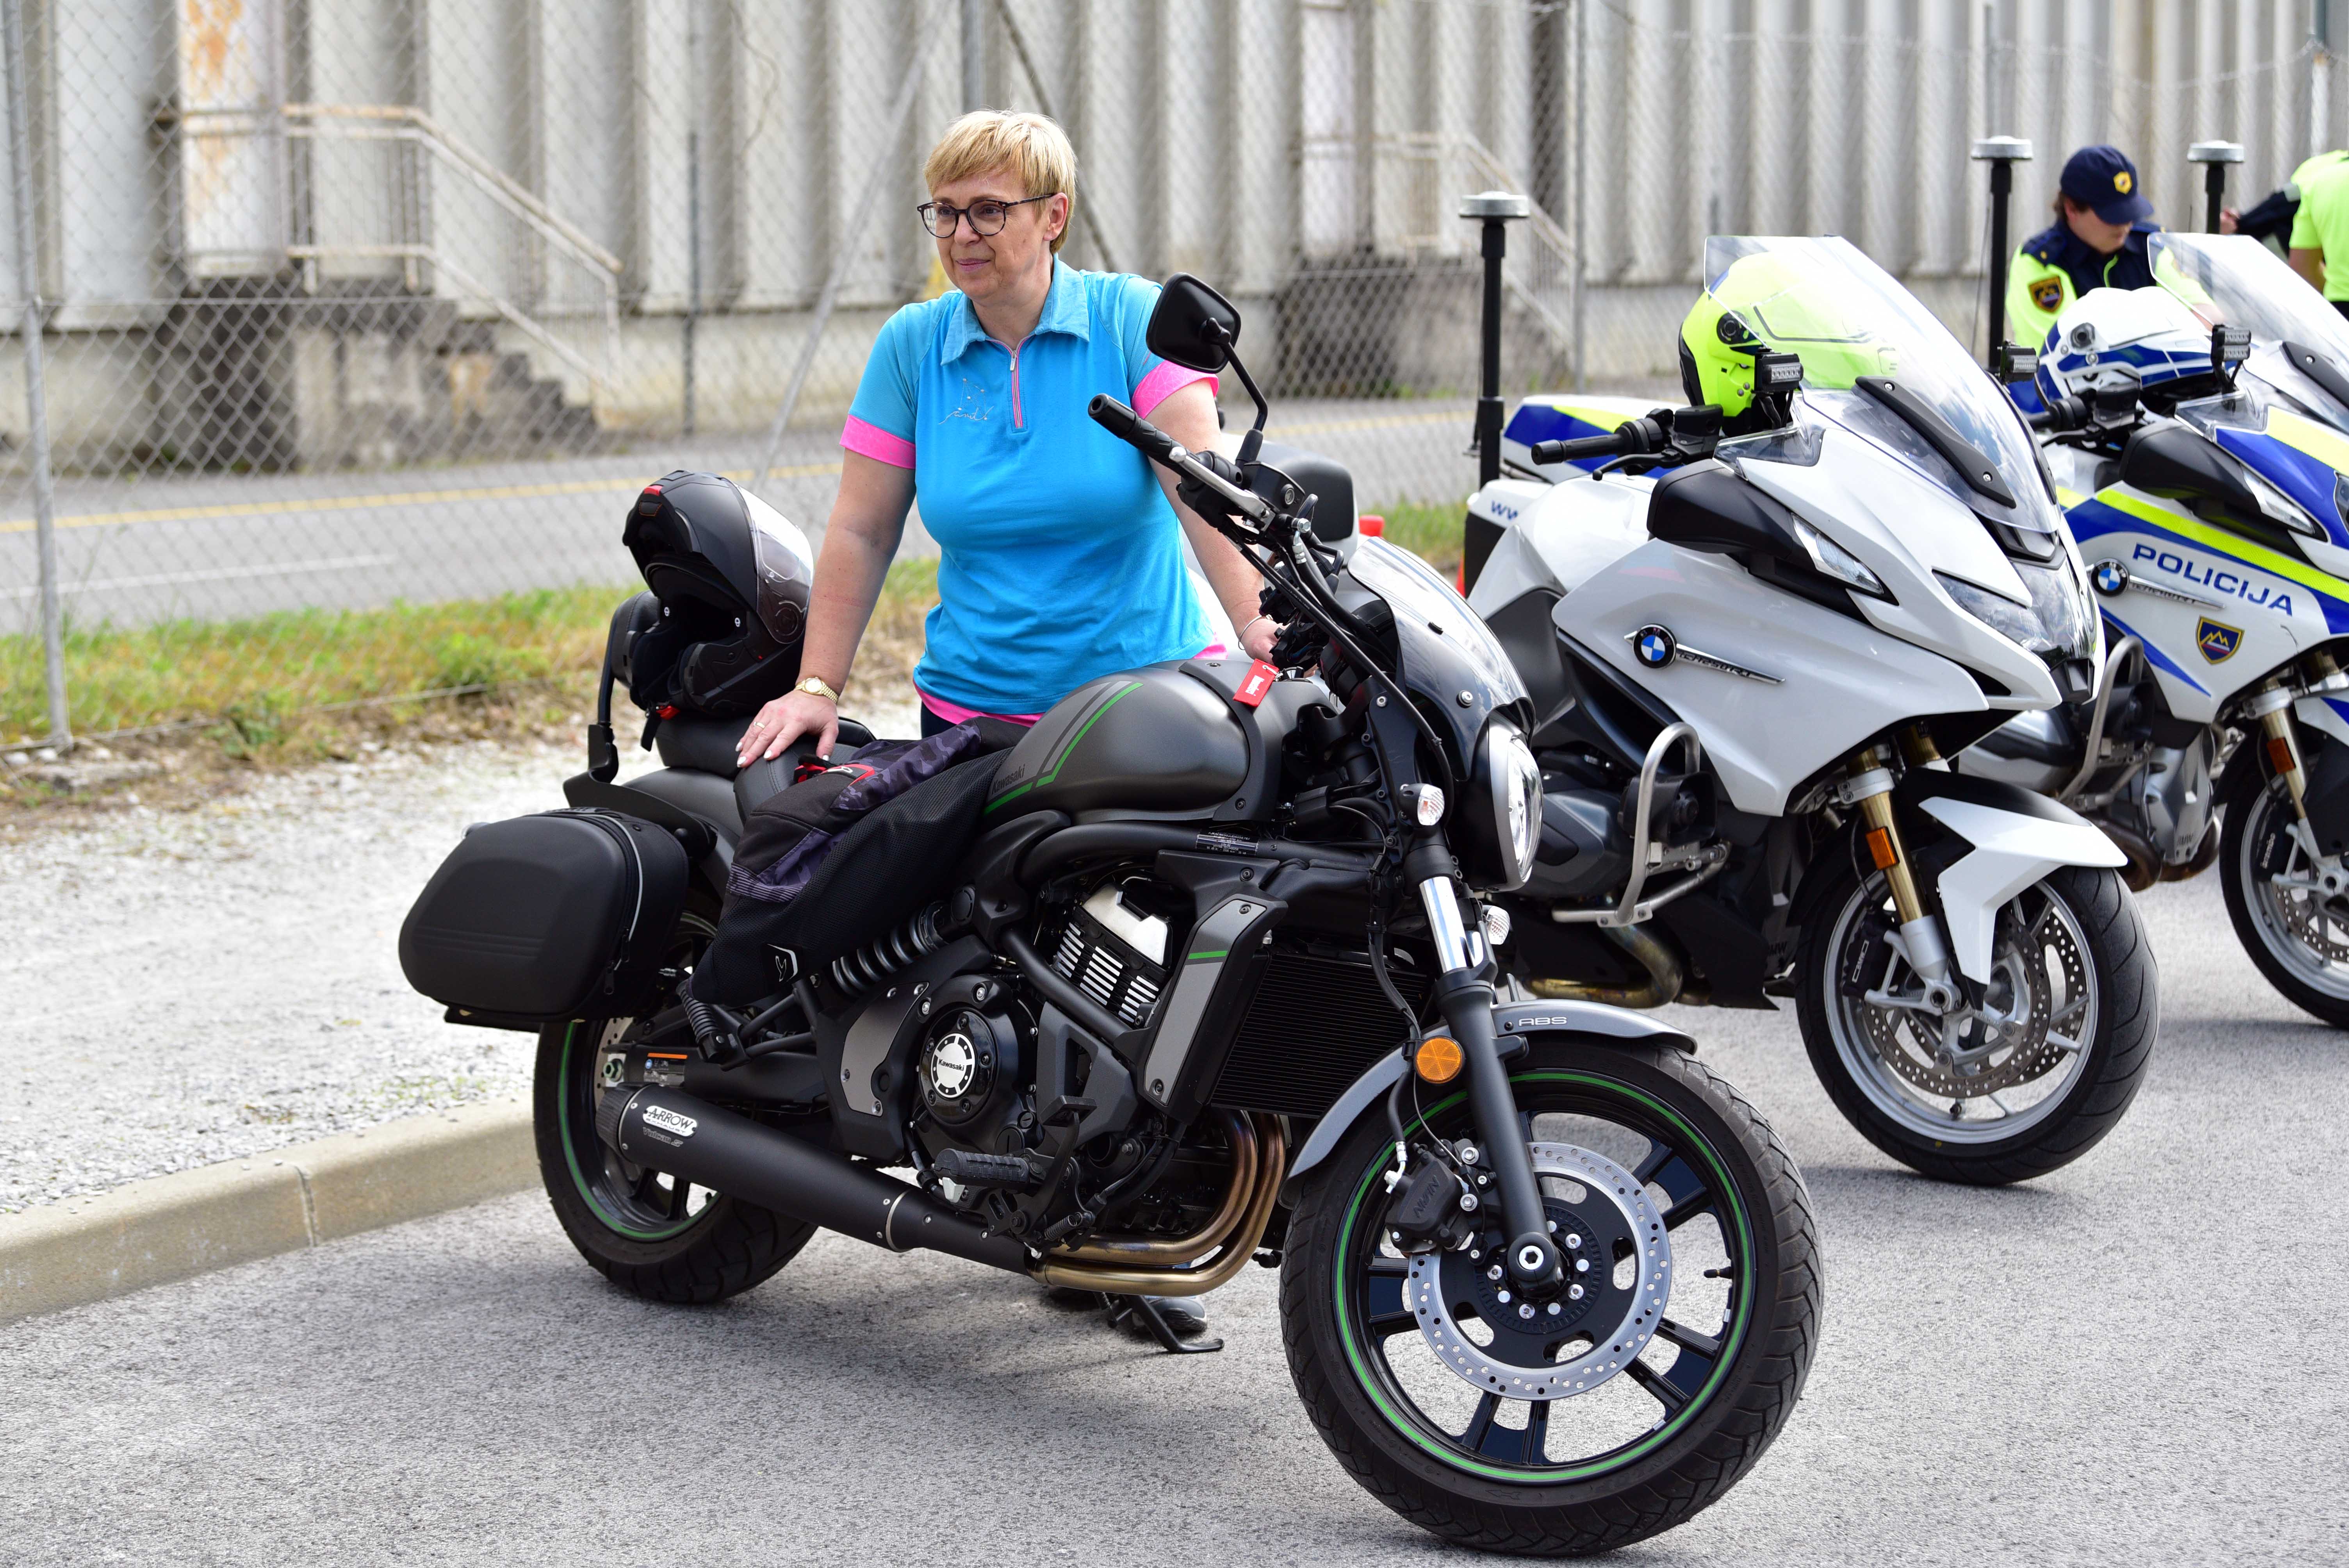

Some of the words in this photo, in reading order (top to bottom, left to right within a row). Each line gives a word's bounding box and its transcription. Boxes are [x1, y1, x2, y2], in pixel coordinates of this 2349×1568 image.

[2132, 543, 2293, 617] POLICIJA
[1640, 627, 1672, 646] BMW
[991, 763, 1026, 795] Kawasaki
[1518, 1016, 1567, 1026] ABS
[938, 1058, 965, 1071] Kawasaki
[646, 1118, 686, 1133] EXHAUST
[648, 1108, 693, 1129] ARROW
[643, 1126, 671, 1144] Vulcan
[671, 1139, 684, 1147] S
